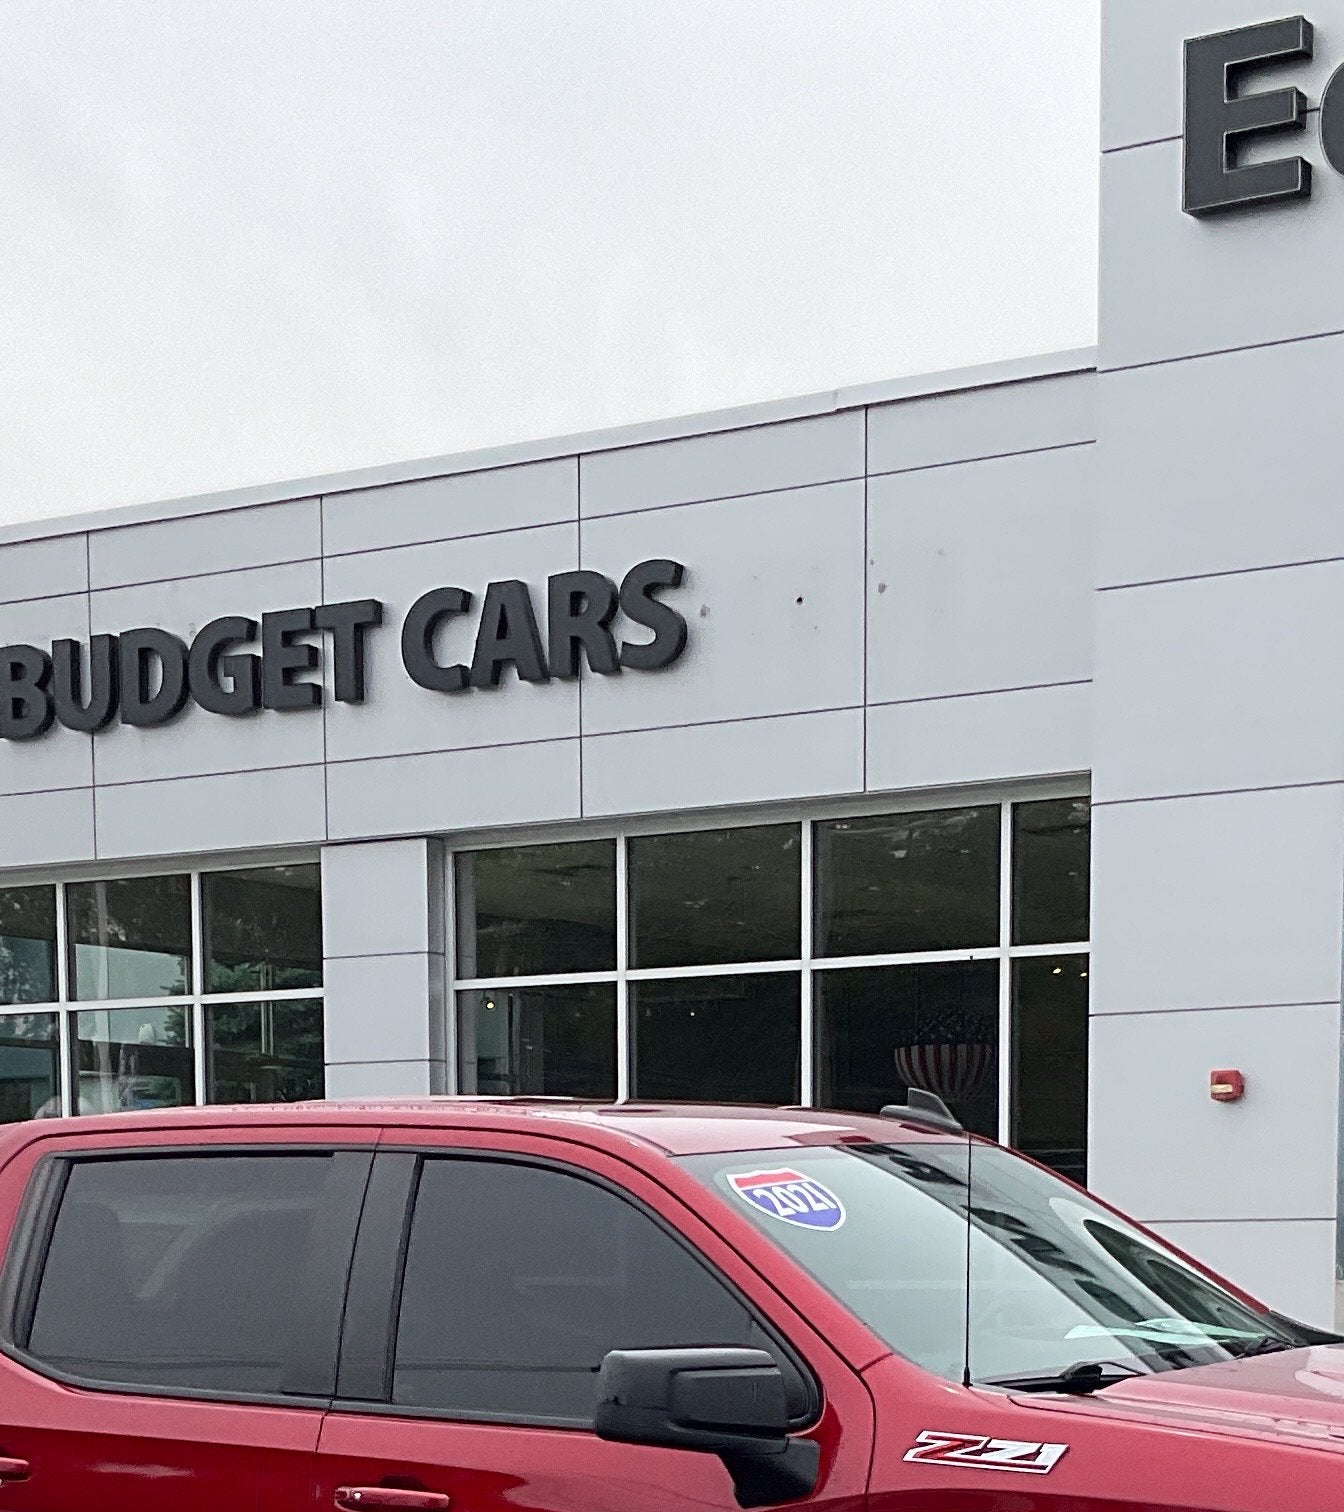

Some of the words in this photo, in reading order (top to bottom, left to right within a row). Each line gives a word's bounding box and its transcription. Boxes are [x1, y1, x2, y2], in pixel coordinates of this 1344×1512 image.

[401, 559, 688, 692] CARS
[752, 1182, 838, 1217] 2021
[902, 1430, 1070, 1475] Z71
